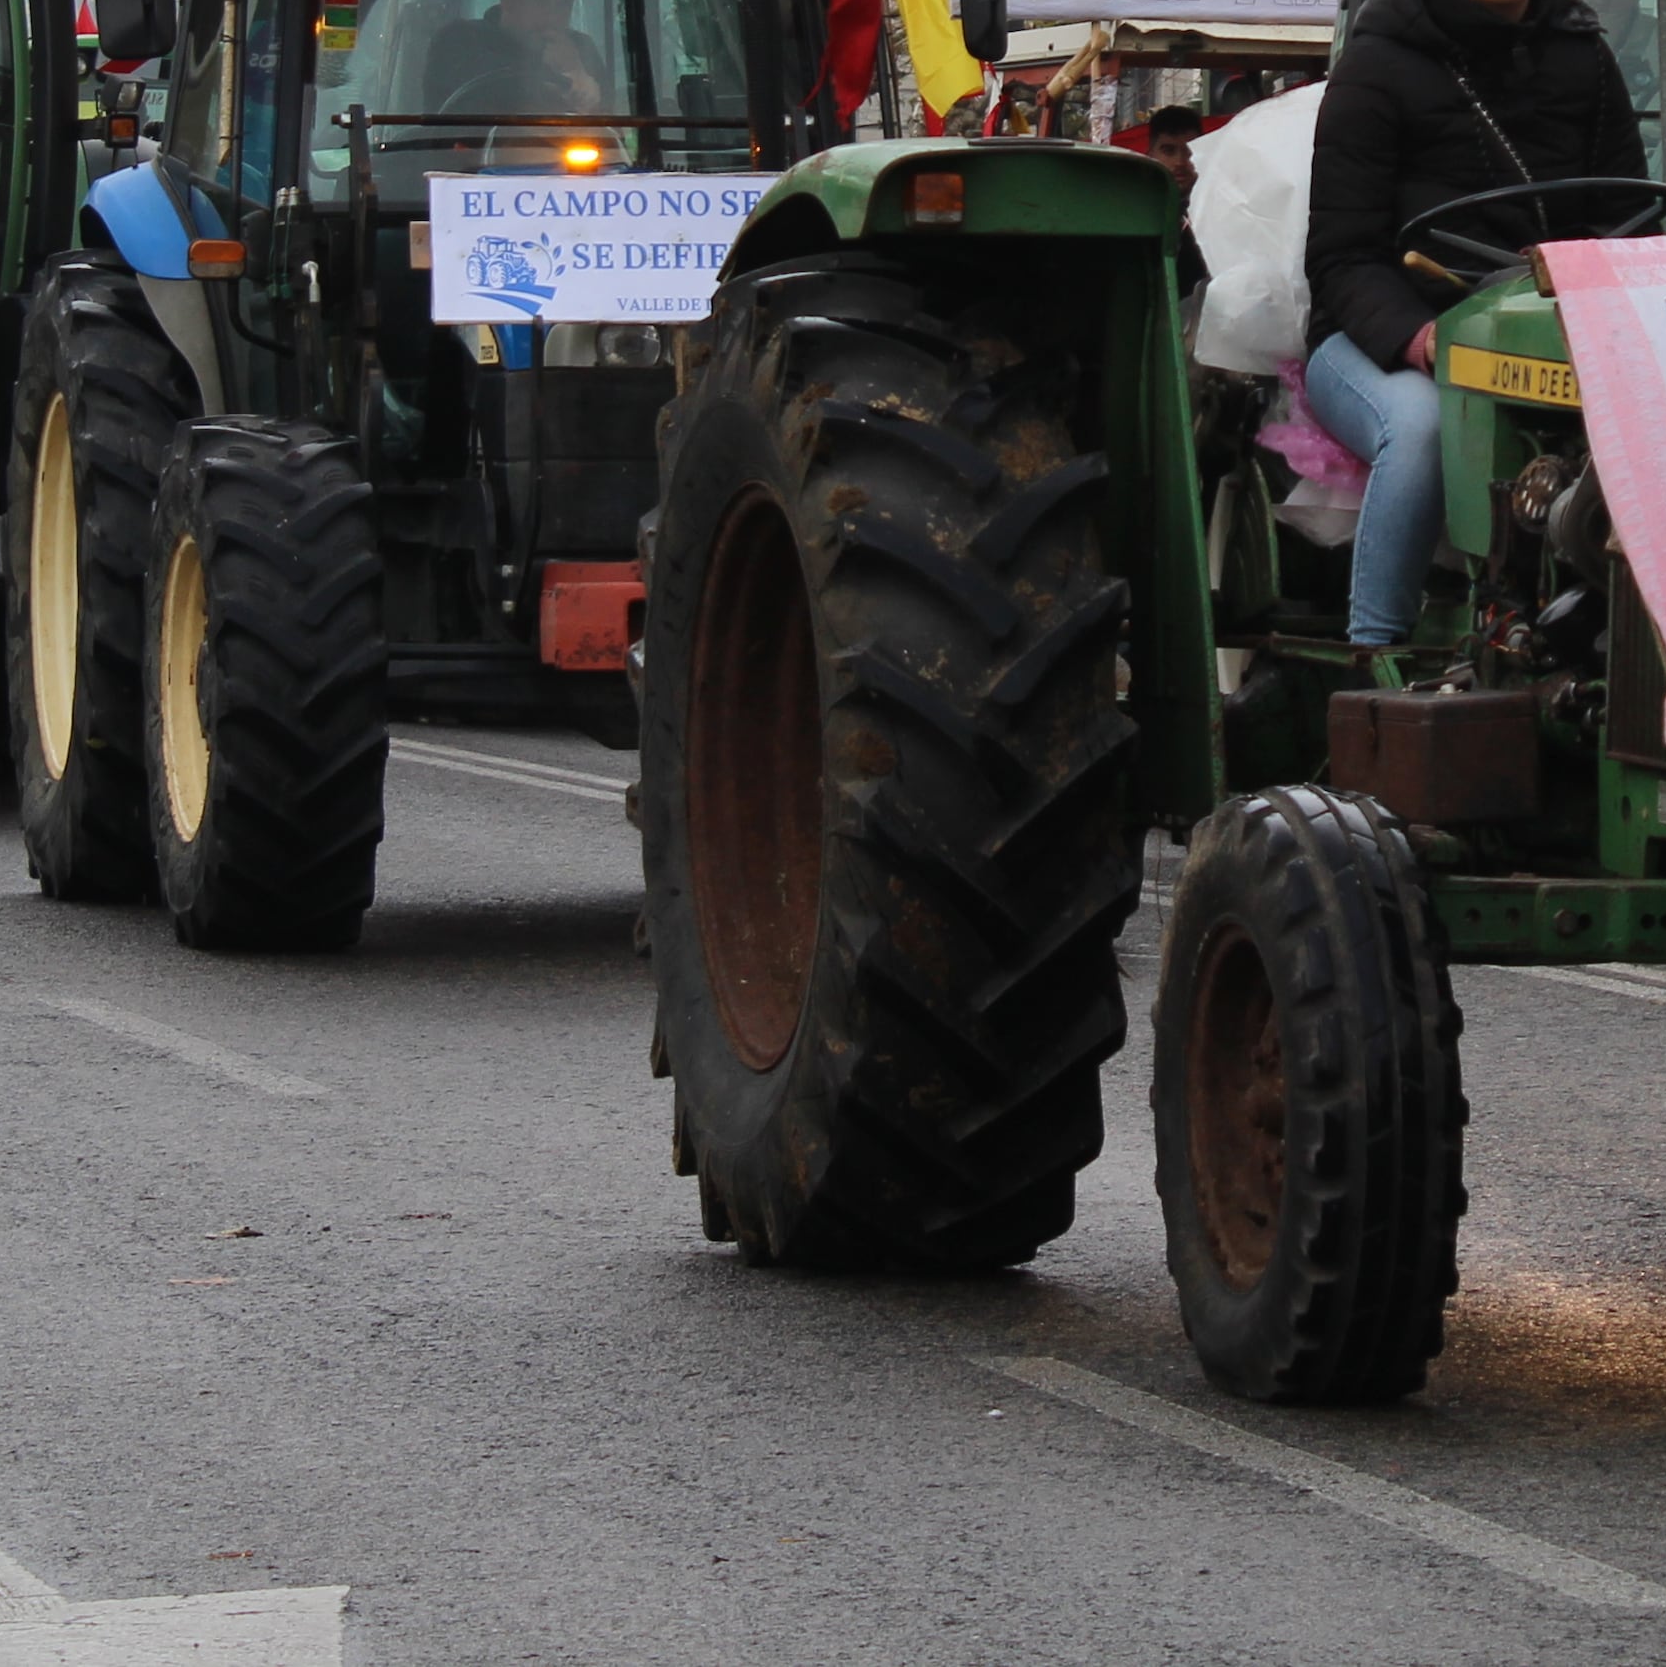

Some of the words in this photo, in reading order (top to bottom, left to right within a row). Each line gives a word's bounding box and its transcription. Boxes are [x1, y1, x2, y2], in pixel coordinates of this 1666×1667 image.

[461, 191, 505, 218] EL
[514, 189, 648, 218] CAMPO
[657, 189, 711, 217] NO
[720, 189, 762, 217] SE
[573, 242, 614, 270] SE
[623, 243, 734, 270] DEFIE
[617, 296, 674, 312] VALLE
[678, 296, 702, 312] DE
[1491, 360, 1531, 393] JOHN
